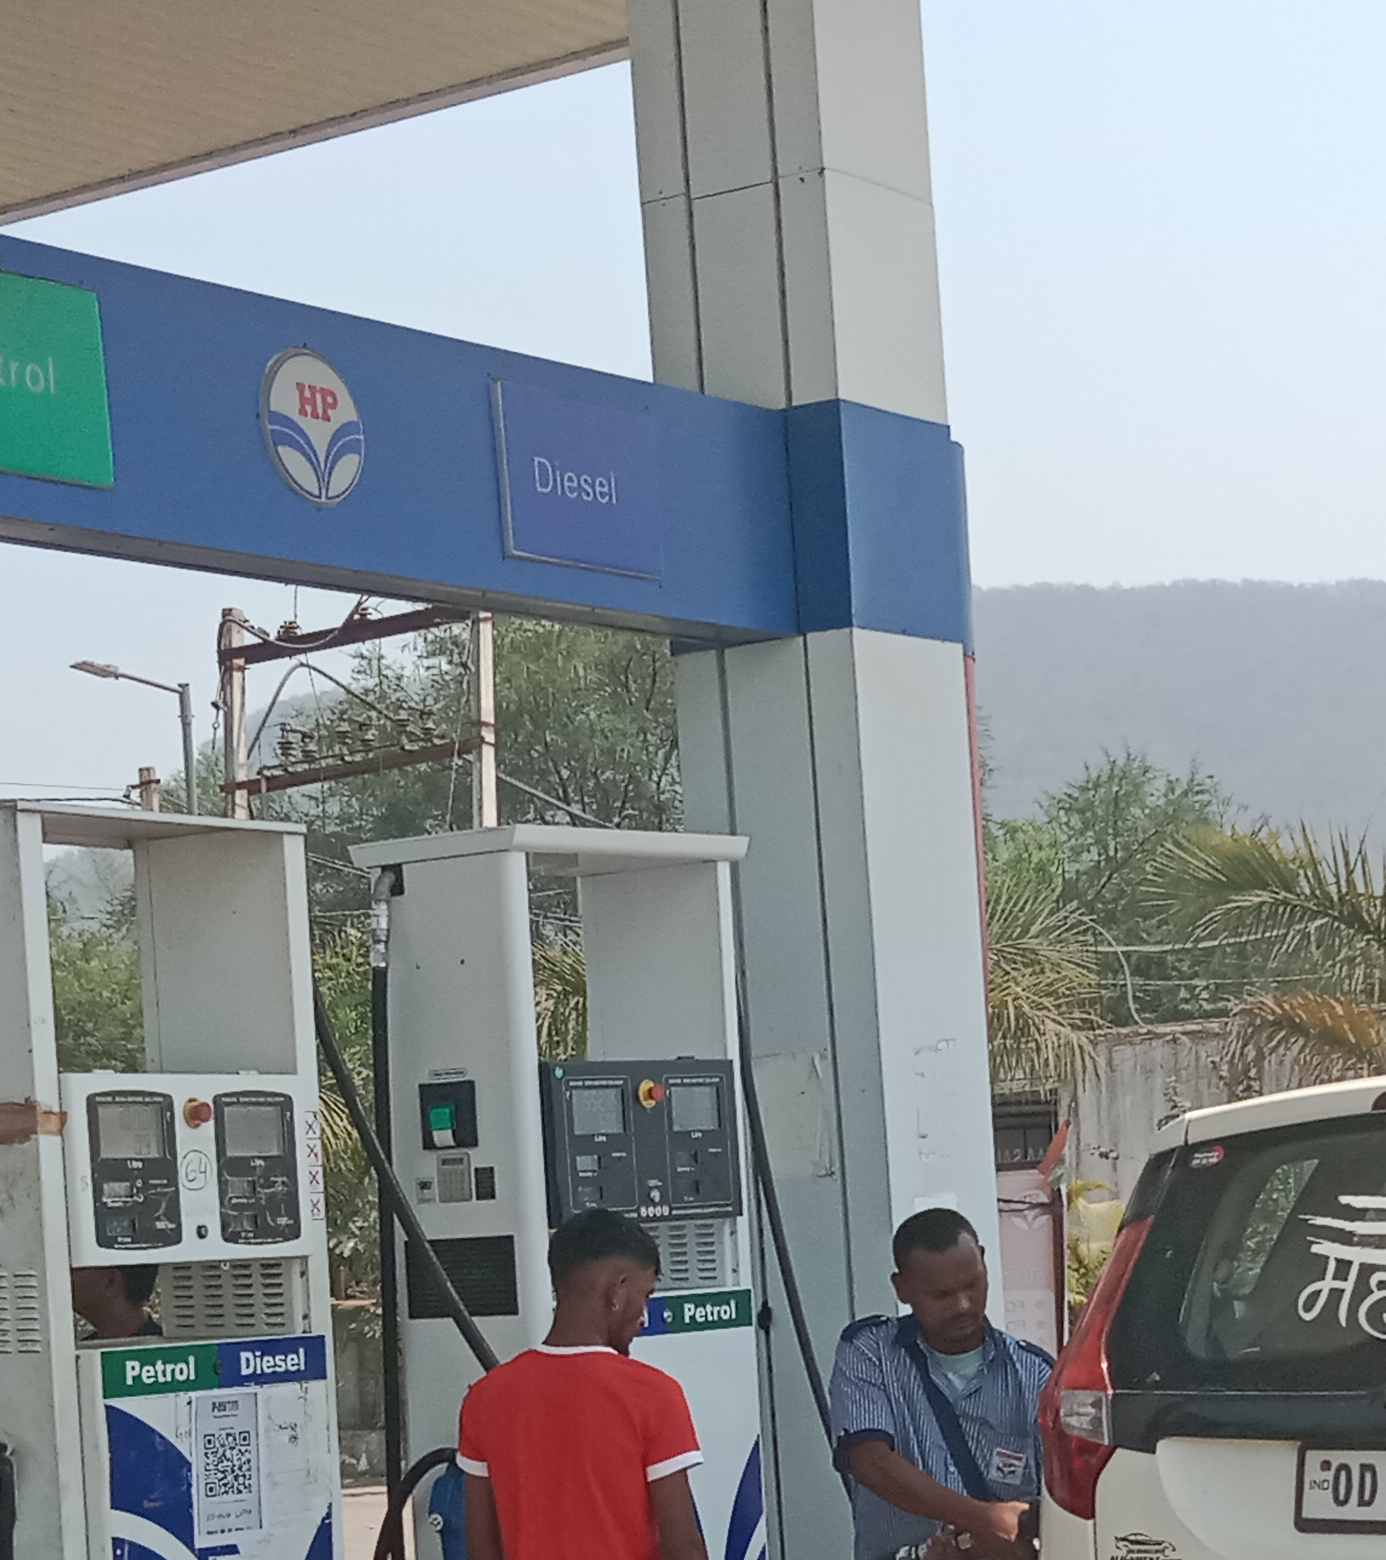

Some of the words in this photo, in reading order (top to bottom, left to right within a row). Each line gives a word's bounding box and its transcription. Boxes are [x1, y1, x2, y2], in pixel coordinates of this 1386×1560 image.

[296, 381, 339, 422] HP
[533, 457, 617, 504] Diesel
[185, 1156, 208, 1183] 64
[683, 1298, 736, 1324] Petrol
[125, 1355, 196, 1385] Petrol
[239, 1347, 305, 1376] Diesel
